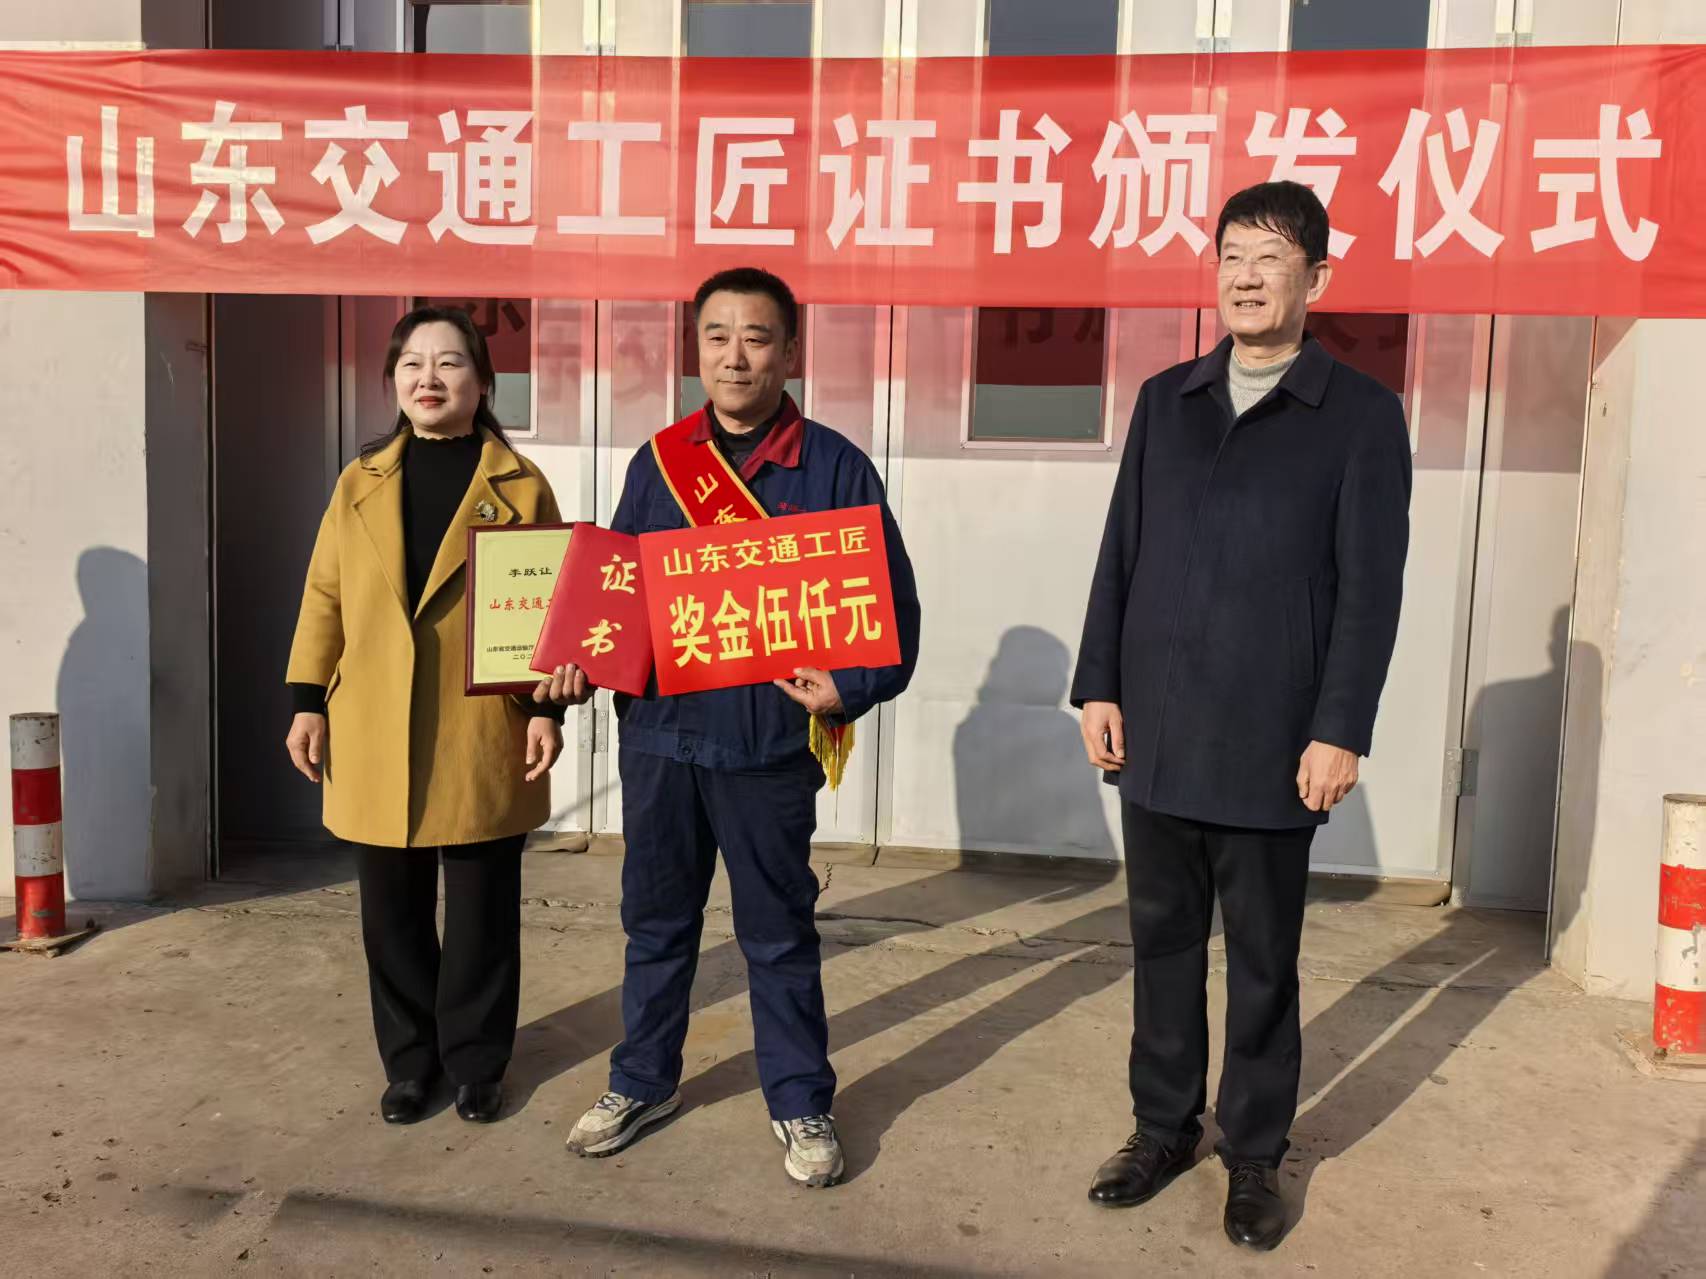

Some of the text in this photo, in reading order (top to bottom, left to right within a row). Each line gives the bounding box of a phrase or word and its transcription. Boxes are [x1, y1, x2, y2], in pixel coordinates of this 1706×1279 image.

[508, 566, 552, 578] 李跃让
[663, 526, 870, 576] 山东交通工匠
[581, 554, 637, 656] 证书
[668, 577, 882, 668] 奖金伍仟元
